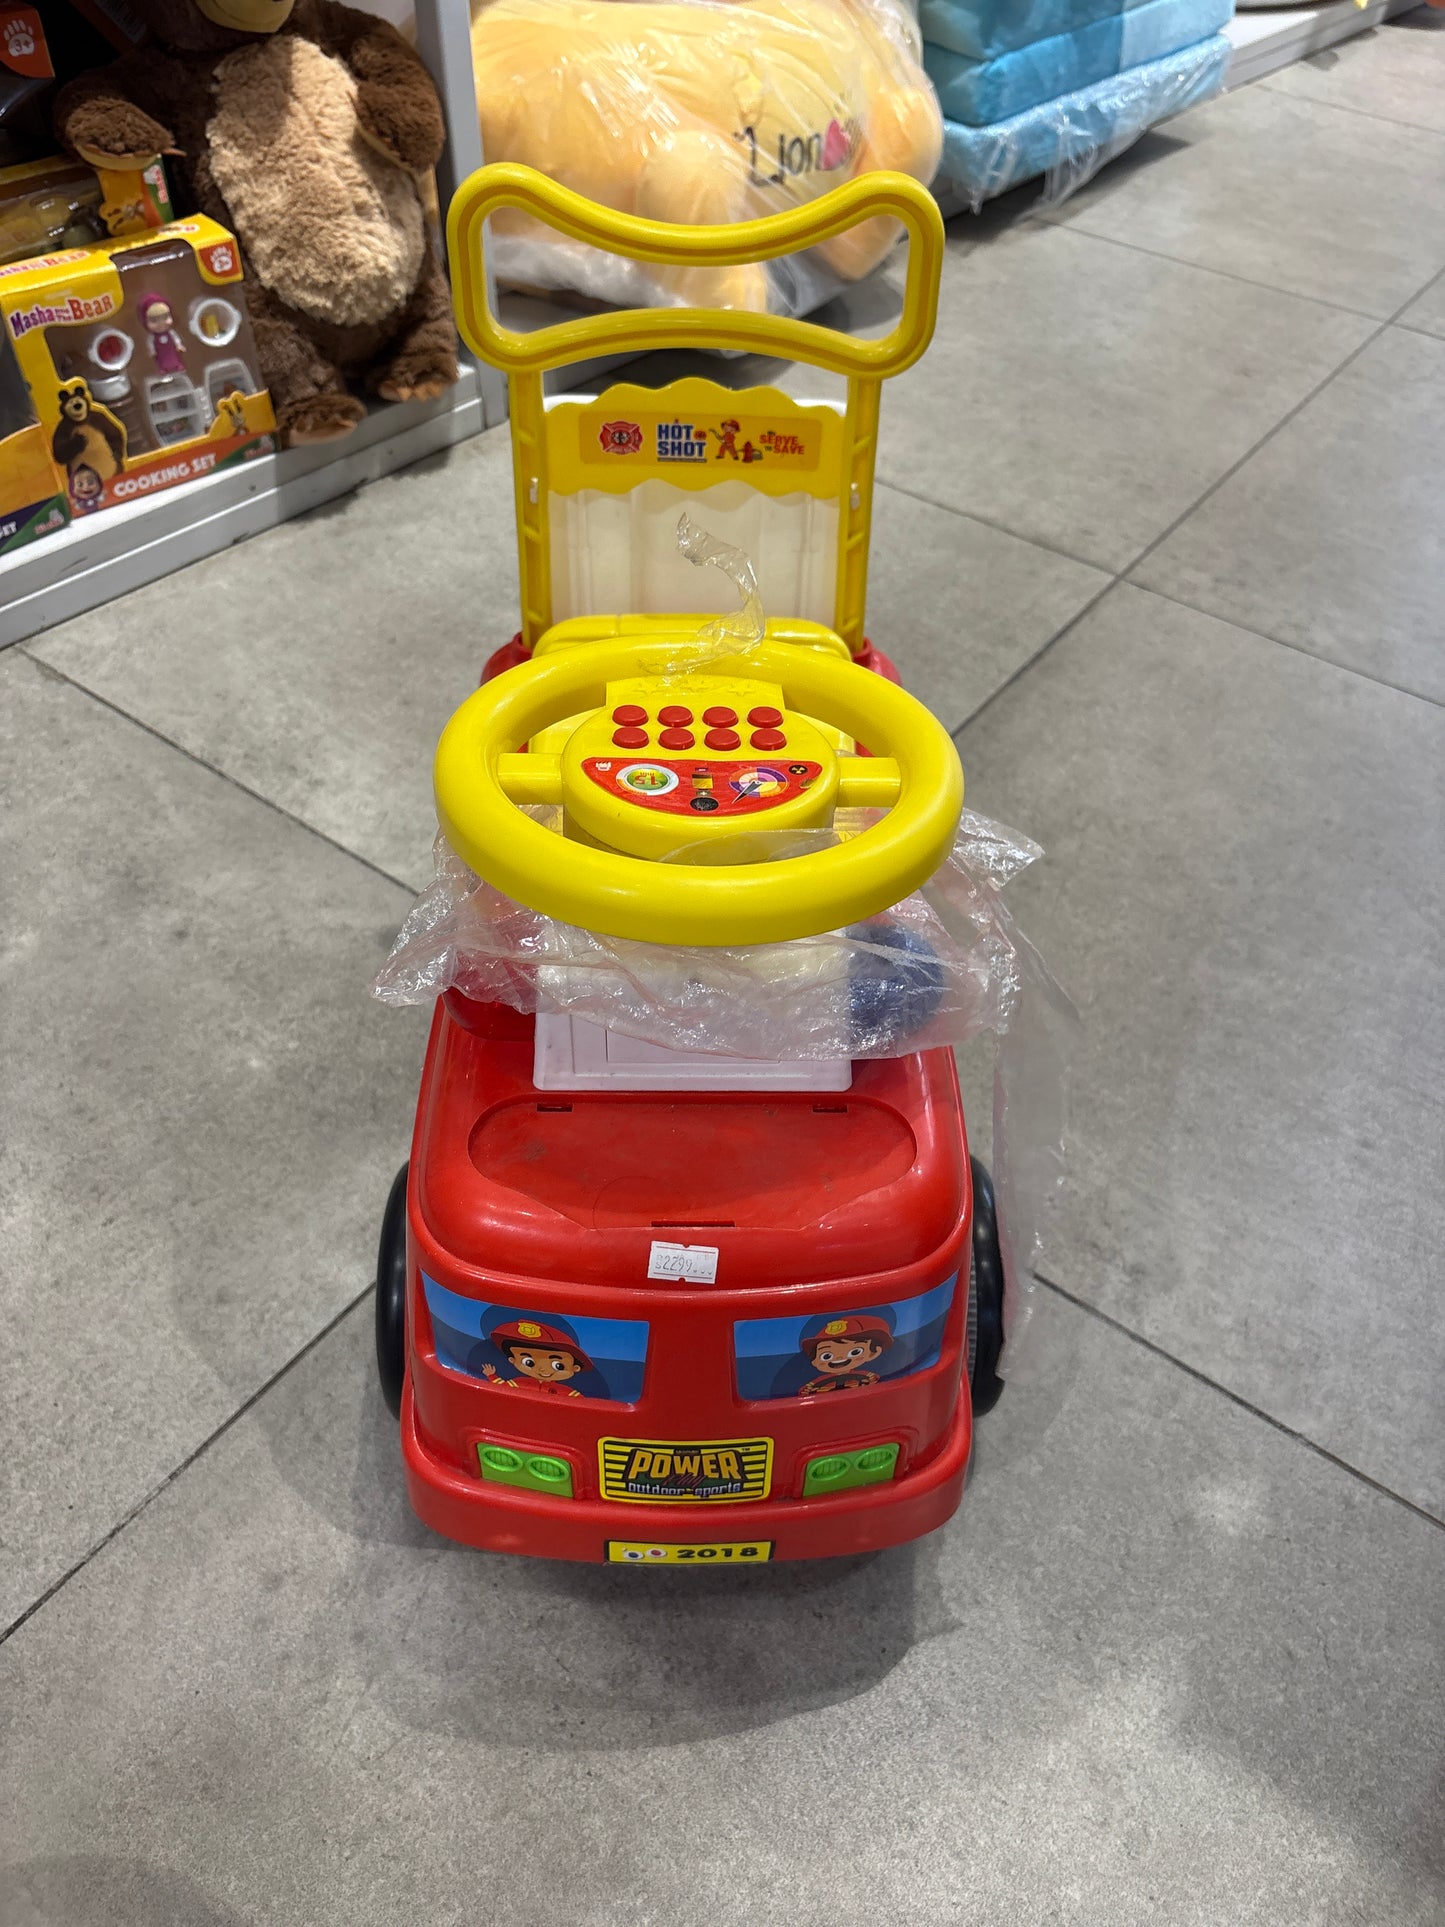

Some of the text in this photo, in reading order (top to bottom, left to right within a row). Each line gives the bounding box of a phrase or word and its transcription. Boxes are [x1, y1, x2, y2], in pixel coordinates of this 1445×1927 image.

[10, 305, 55, 337] Masha
[657, 423, 693, 440] HOT
[759, 434, 799, 445] SERVE
[657, 441, 706, 457] SHOT
[773, 443, 805, 455] SAVE
[113, 462, 190, 497] COOKING
[192, 453, 216, 472] SET
[0, 521, 17, 539] ET
[628, 1449, 742, 1480] POWER
[628, 1481, 741, 1498] outdoor sports
[676, 1546, 759, 1559] 2018
